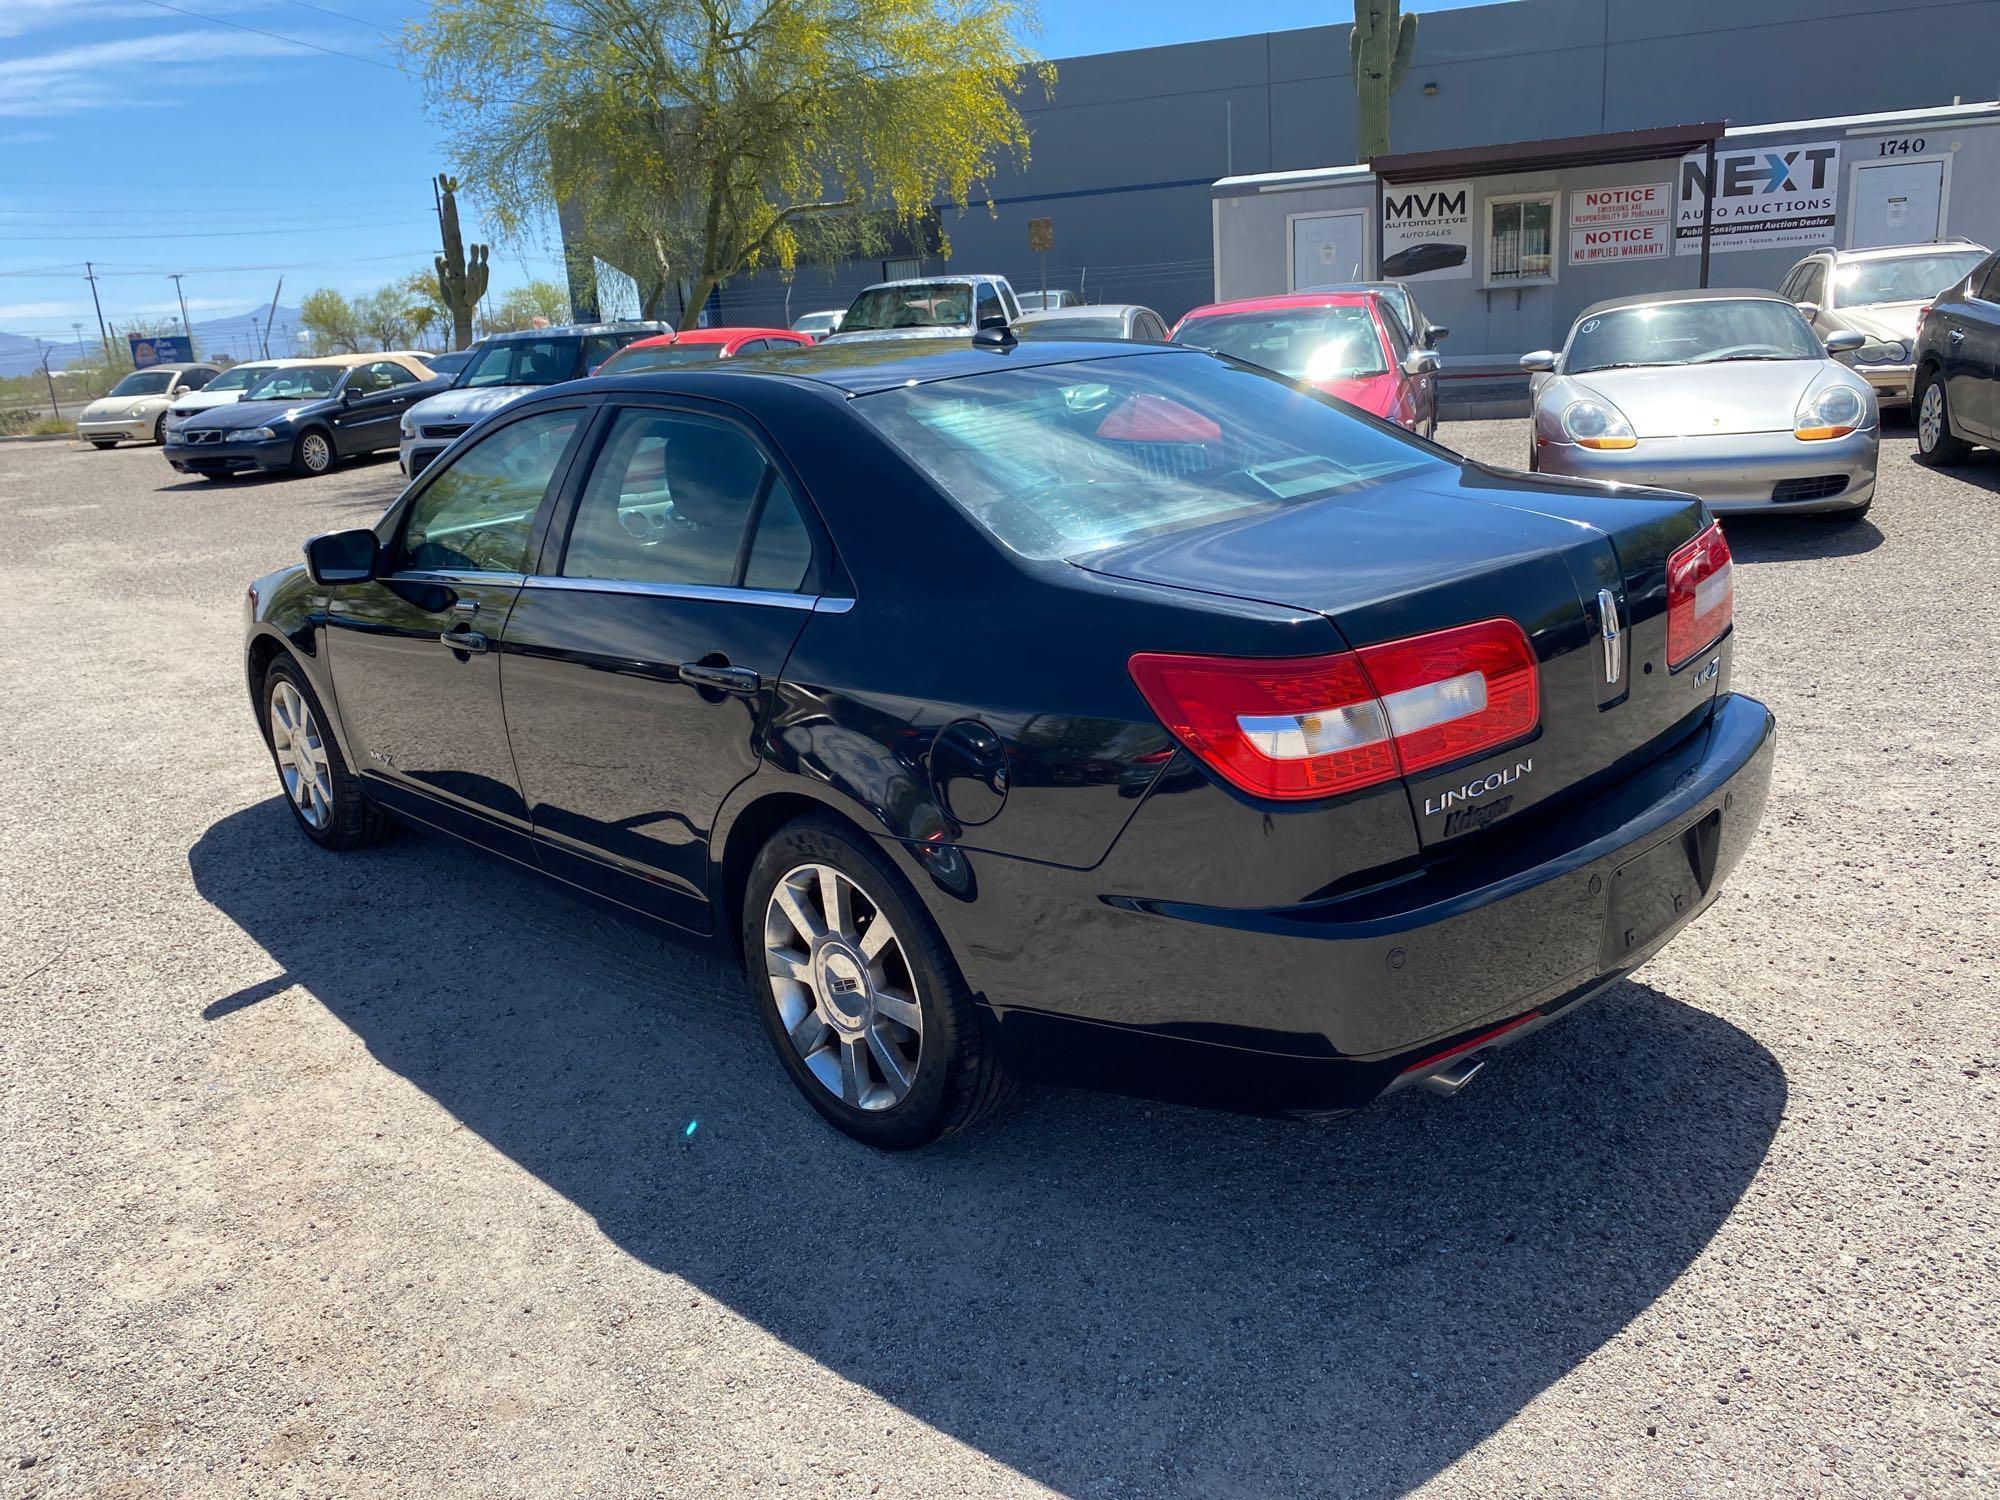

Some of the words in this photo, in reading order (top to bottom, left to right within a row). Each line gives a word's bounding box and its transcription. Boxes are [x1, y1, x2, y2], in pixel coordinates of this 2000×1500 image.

[1879, 138, 1925, 156] 1740
[1682, 148, 1836, 201] NEXT
[1386, 190, 1465, 220] MVM
[1586, 188, 1656, 206] NOTICE
[1575, 212, 1620, 223] RESPONSIBILITY
[1631, 208, 1665, 218] PURCHASER
[1598, 204, 1629, 213] EMISSIONS
[1682, 207, 1728, 220] AUO
[1735, 198, 1831, 216] AUCTIONS
[1385, 217, 1468, 228] AUTOMOTIVE
[1681, 226, 1703, 237] Publi
[1765, 220, 1798, 230] Auction
[1799, 217, 1829, 227] Dealer
[1400, 231, 1424, 239] AUTO
[1425, 229, 1452, 237] SALES
[1585, 227, 1654, 245] NOTICE
[1575, 248, 1585, 260] NO
[1588, 246, 1618, 259] IMPLIED
[1621, 243, 1664, 256] WARRANTY
[1692, 656, 1720, 689] MKZ
[1425, 758, 1532, 816] LINCOLN
